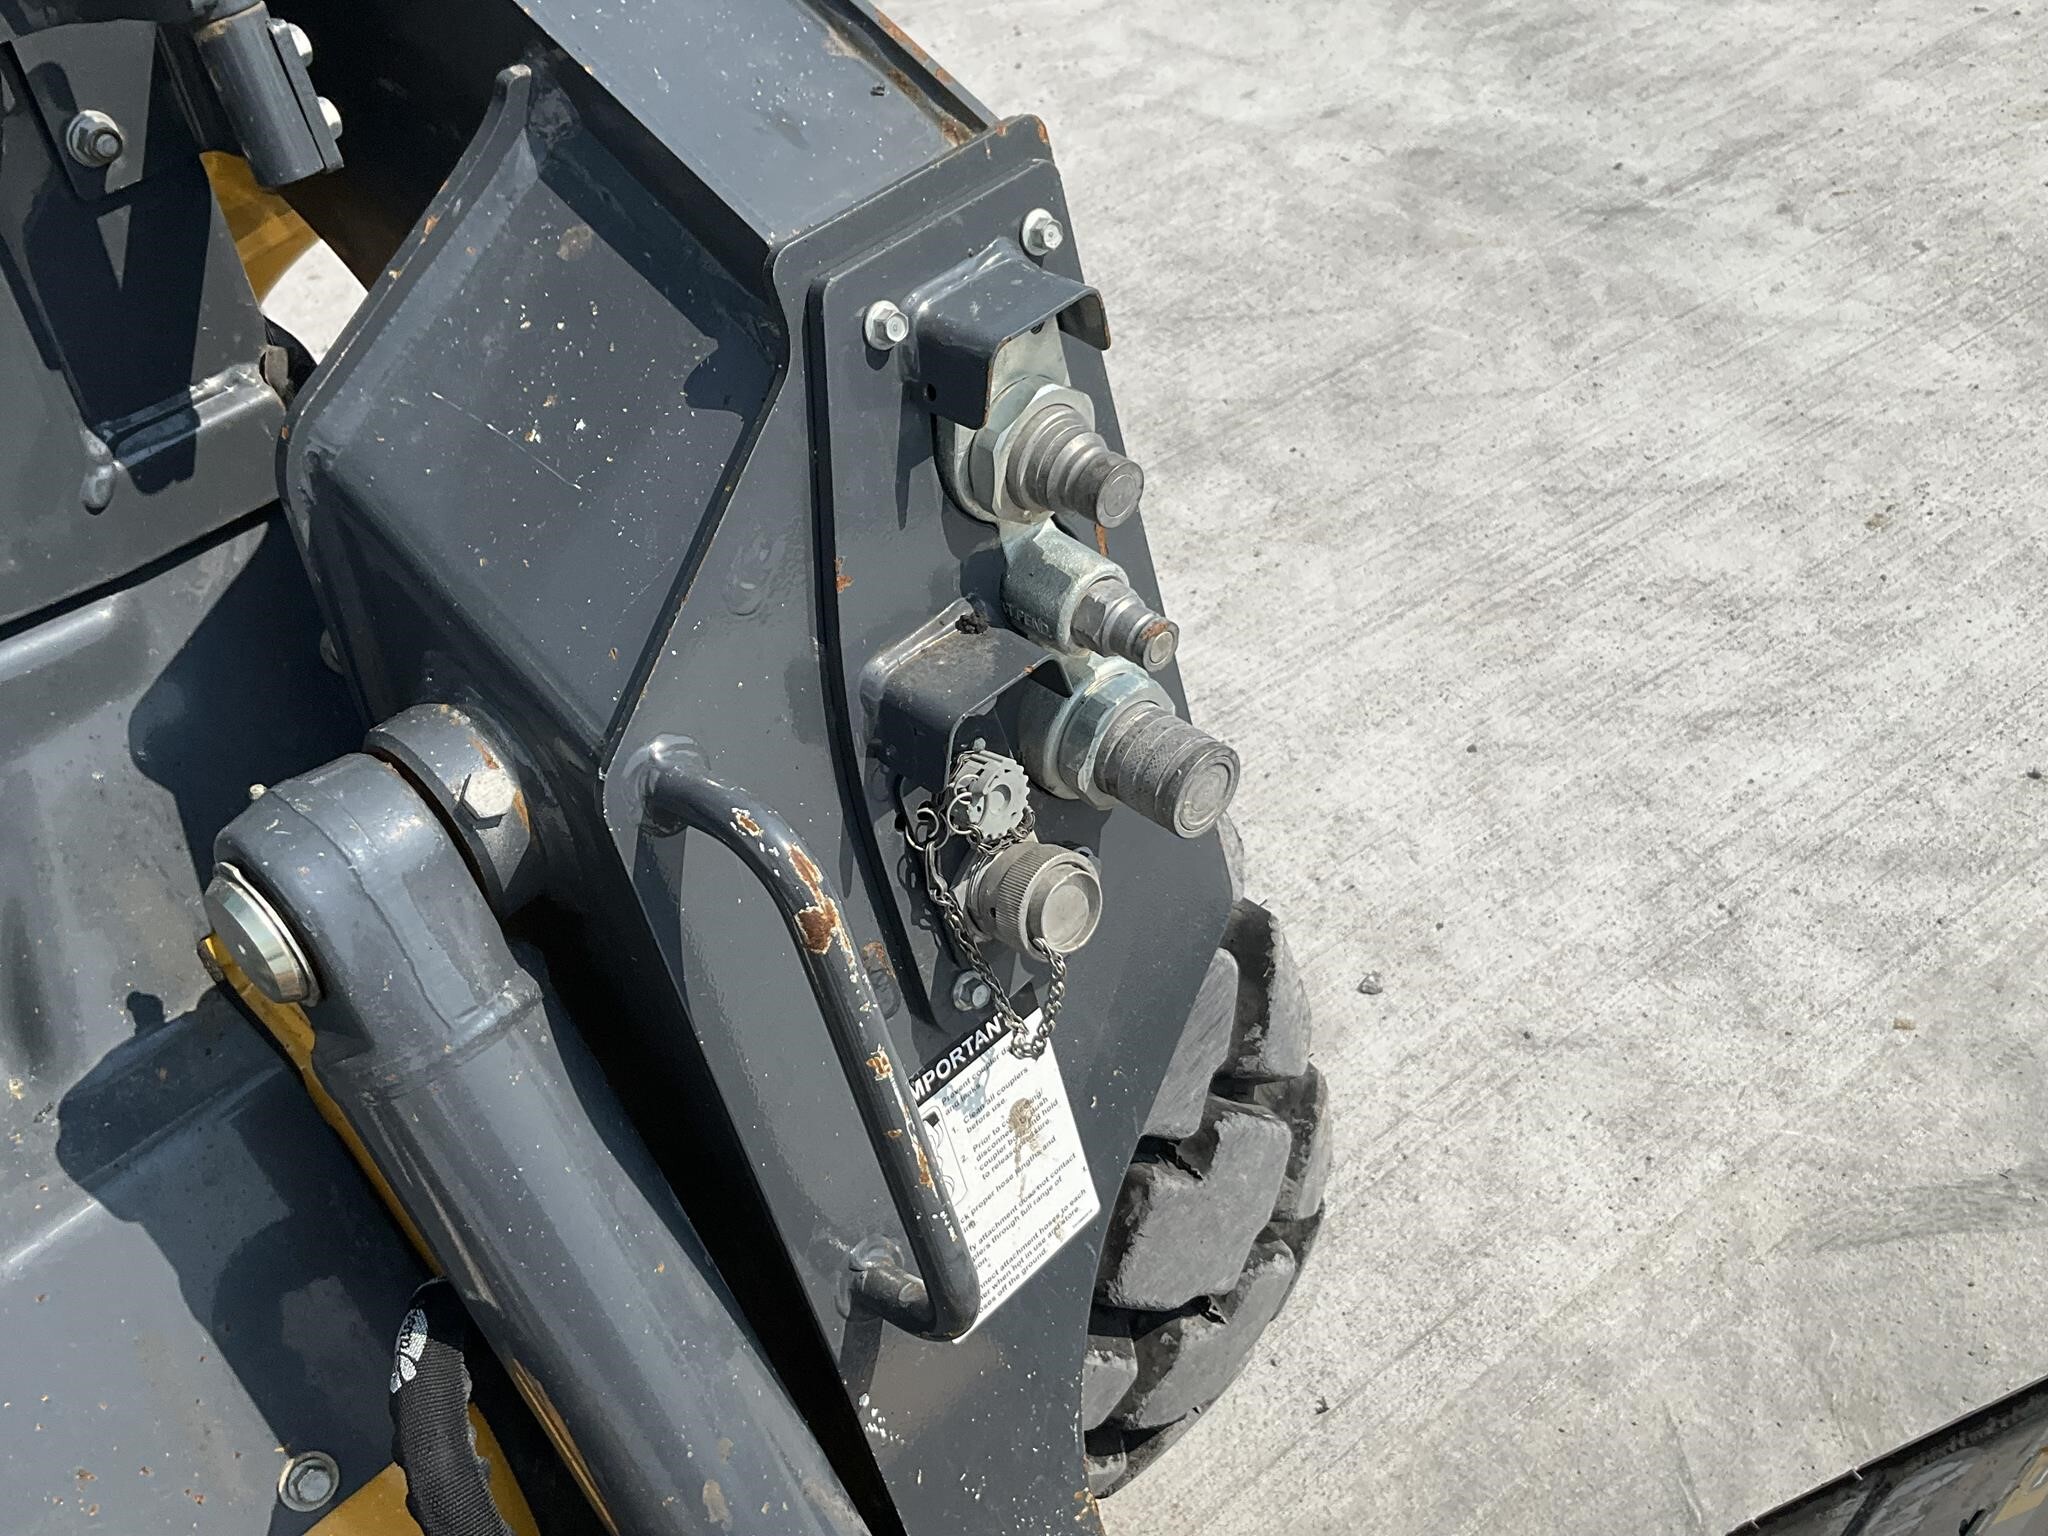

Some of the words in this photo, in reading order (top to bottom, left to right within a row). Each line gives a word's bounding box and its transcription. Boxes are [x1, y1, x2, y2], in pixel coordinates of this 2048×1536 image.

[909, 1010, 1006, 1103] MPORTAN
[941, 1076, 971, 1106] Prevent
[970, 1052, 999, 1082] coupler
[944, 1099, 959, 1115] and
[962, 1101, 985, 1125] Clean
[984, 1092, 995, 1105] all
[996, 1067, 1028, 1096] couplers
[966, 1110, 990, 1134] before
[991, 1097, 1007, 1112] use.
[972, 1133, 990, 1152] Prior
[991, 1126, 1000, 1135] to
[979, 1143, 1006, 1171] coupler
[1041, 1097, 1058, 1116] hold
[981, 1170, 990, 1180] to
[990, 1145, 1017, 1172] release
[970, 1190, 994, 1216] proper
[995, 1173, 1014, 1192] hose
[1040, 1135, 1056, 1153] and
[978, 1204, 1017, 1244] attachment
[1017, 1186, 1036, 1208] does
[1035, 1175, 1049, 1191] not
[1049, 1152, 1076, 1178] contact
[991, 1215, 1020, 1243] through
[1019, 1202, 1032, 1217] full
[1032, 1184, 1053, 1205] range
[1053, 1175, 1062, 1186] of
[991, 1264, 1011, 1290] when
[1024, 1250, 1032, 1259] in
[1032, 1236, 1046, 1251] use
[1046, 1221, 1060, 1238] and
[1060, 1205, 1079, 1225] store
[999, 1231, 1038, 1271] attachment
[1038, 1210, 1060, 1235] hoses
[1060, 1202, 1069, 1214] to
[1069, 1188, 1086, 1206] each
[978, 1296, 996, 1313] oses
[996, 1283, 1007, 1296] off
[1007, 1273, 1020, 1286] the
[1020, 1247, 1047, 1275] ground.
